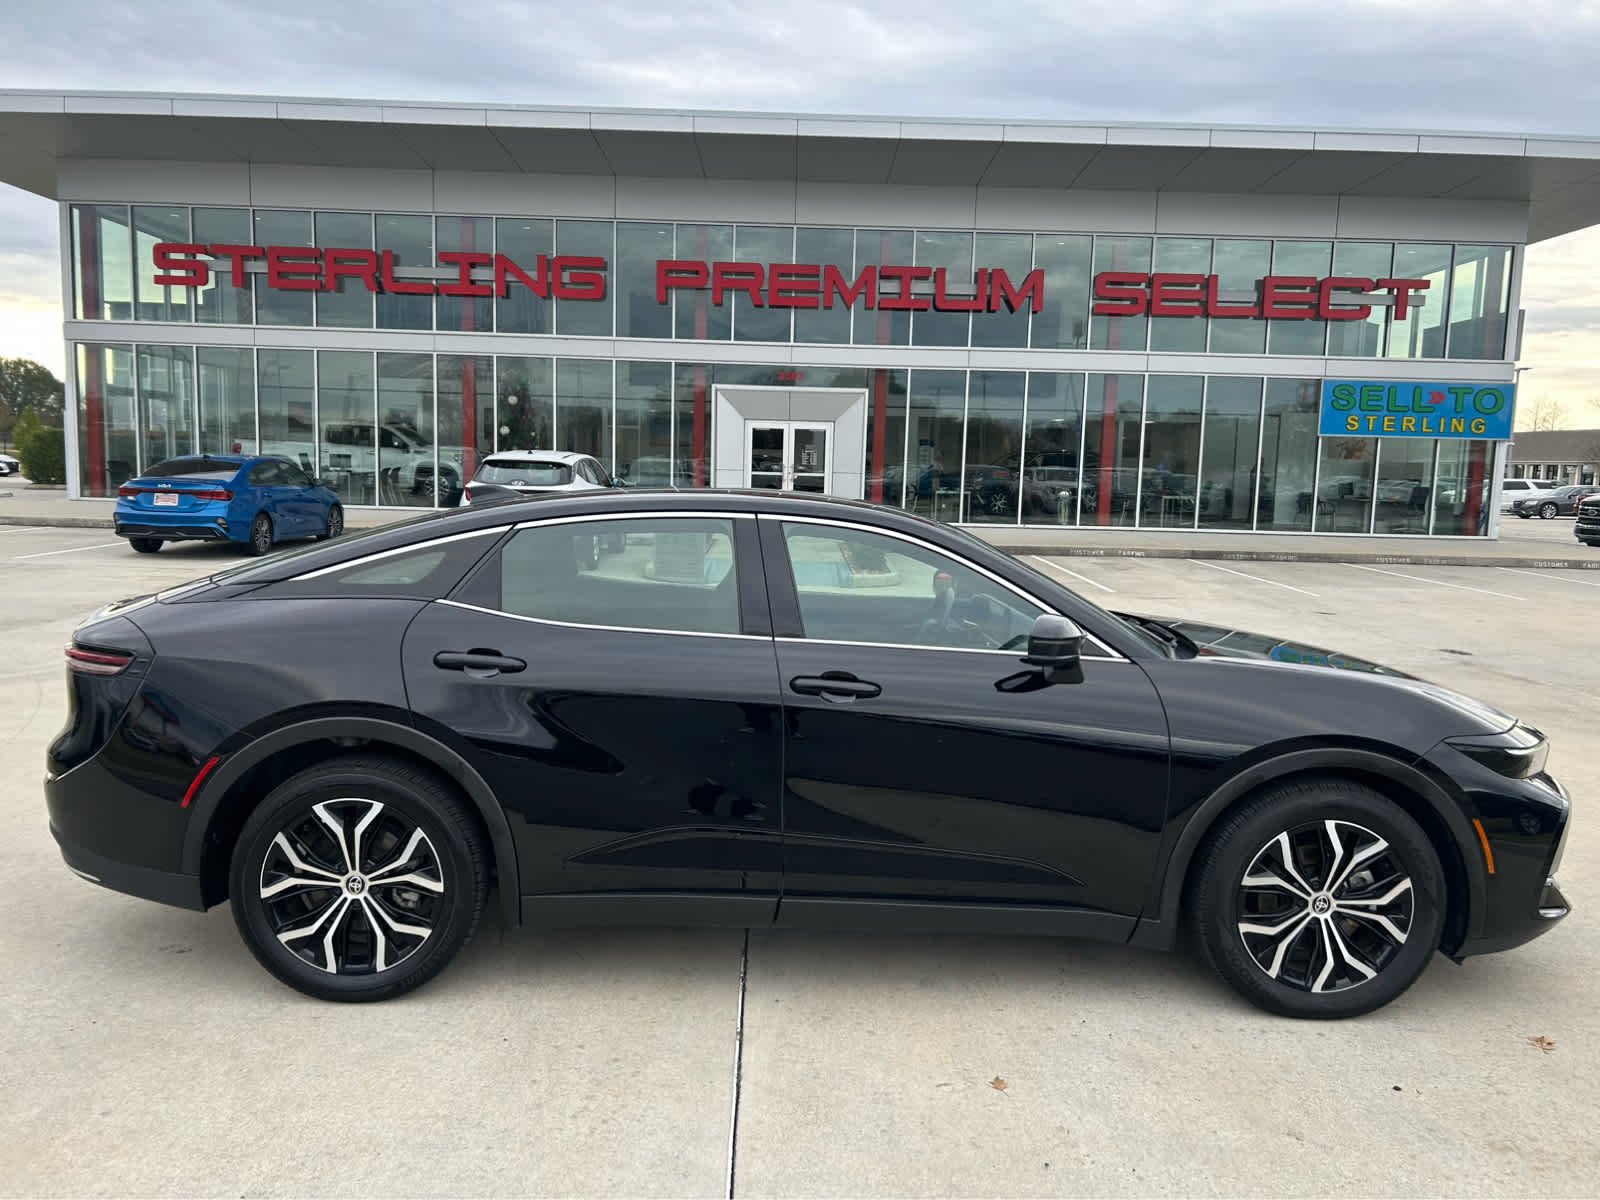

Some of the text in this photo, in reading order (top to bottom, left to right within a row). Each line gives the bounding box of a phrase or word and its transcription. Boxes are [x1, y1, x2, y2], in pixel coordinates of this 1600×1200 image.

[153, 243, 1431, 321] STERLING PREMIUM SELECT
[1330, 383, 1506, 415] SELL TO
[1345, 415, 1487, 434] STERLING
